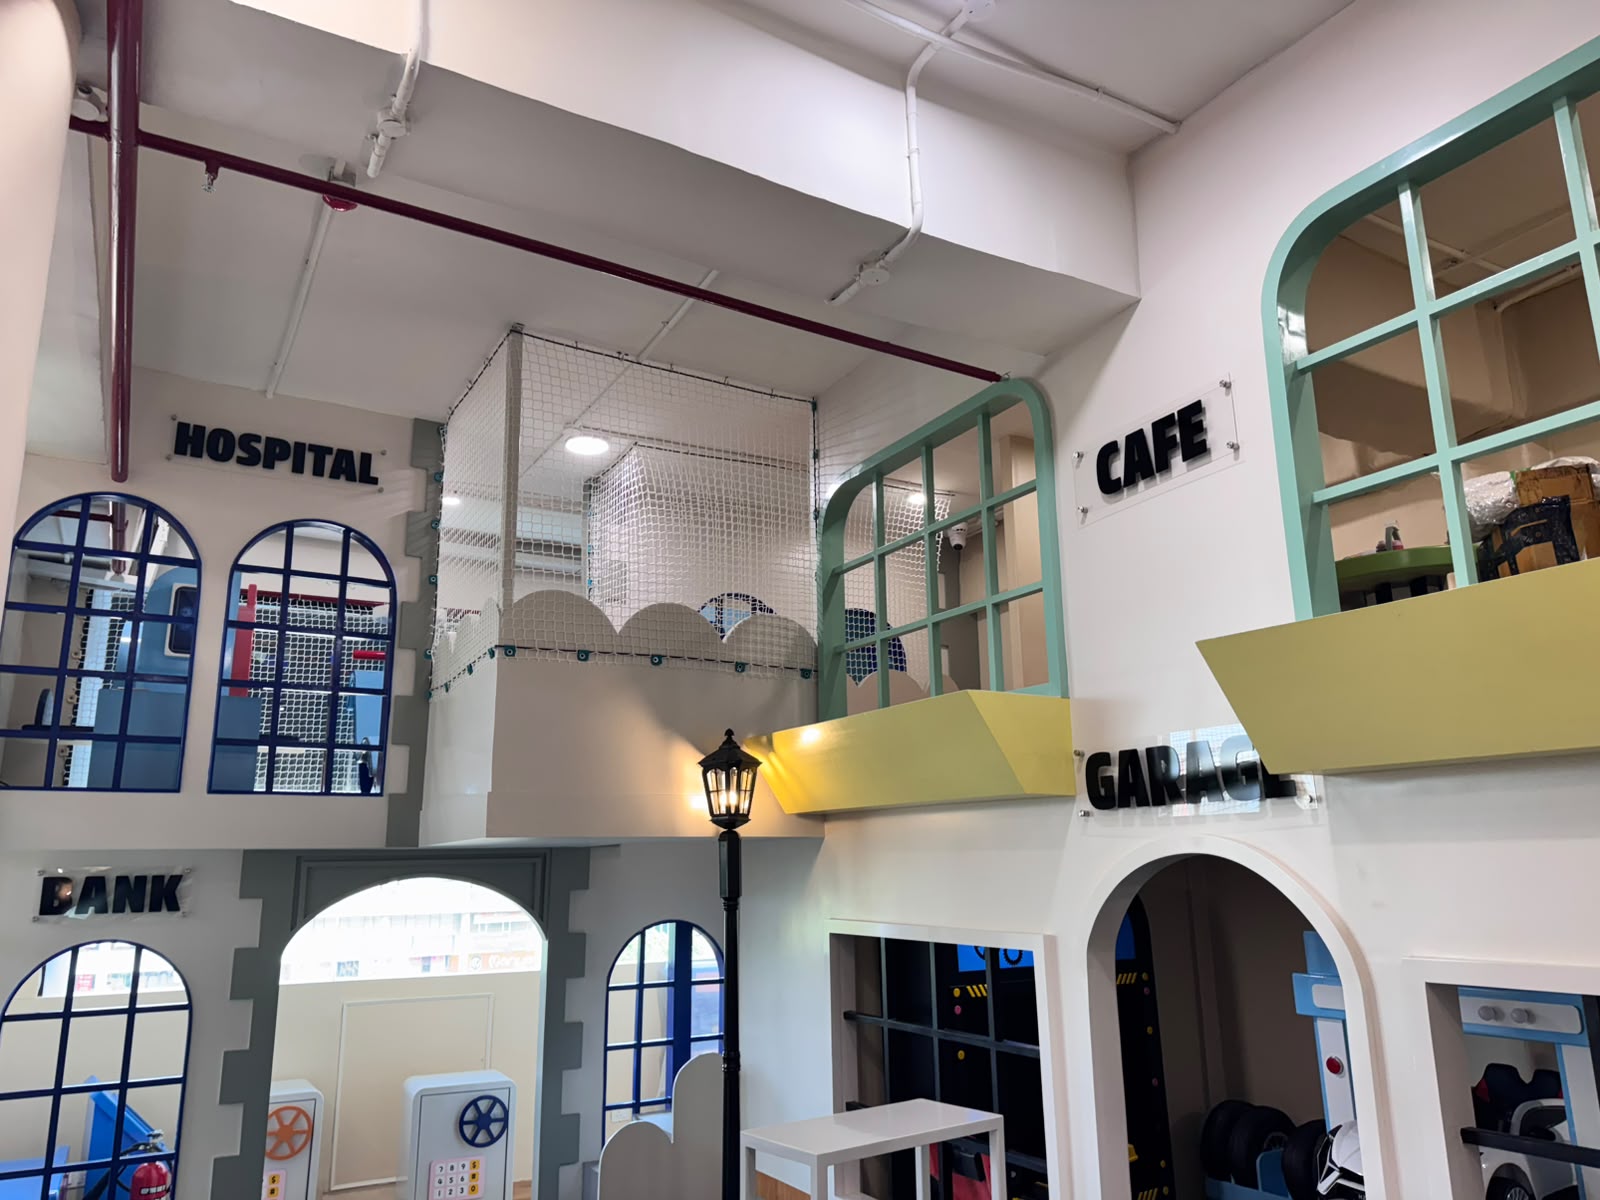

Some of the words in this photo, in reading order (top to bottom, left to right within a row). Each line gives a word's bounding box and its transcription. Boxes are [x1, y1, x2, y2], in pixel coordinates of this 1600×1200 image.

[174, 421, 379, 485] HOSPITAL
[1096, 399, 1207, 495] CAFE
[39, 874, 184, 915] BANK
